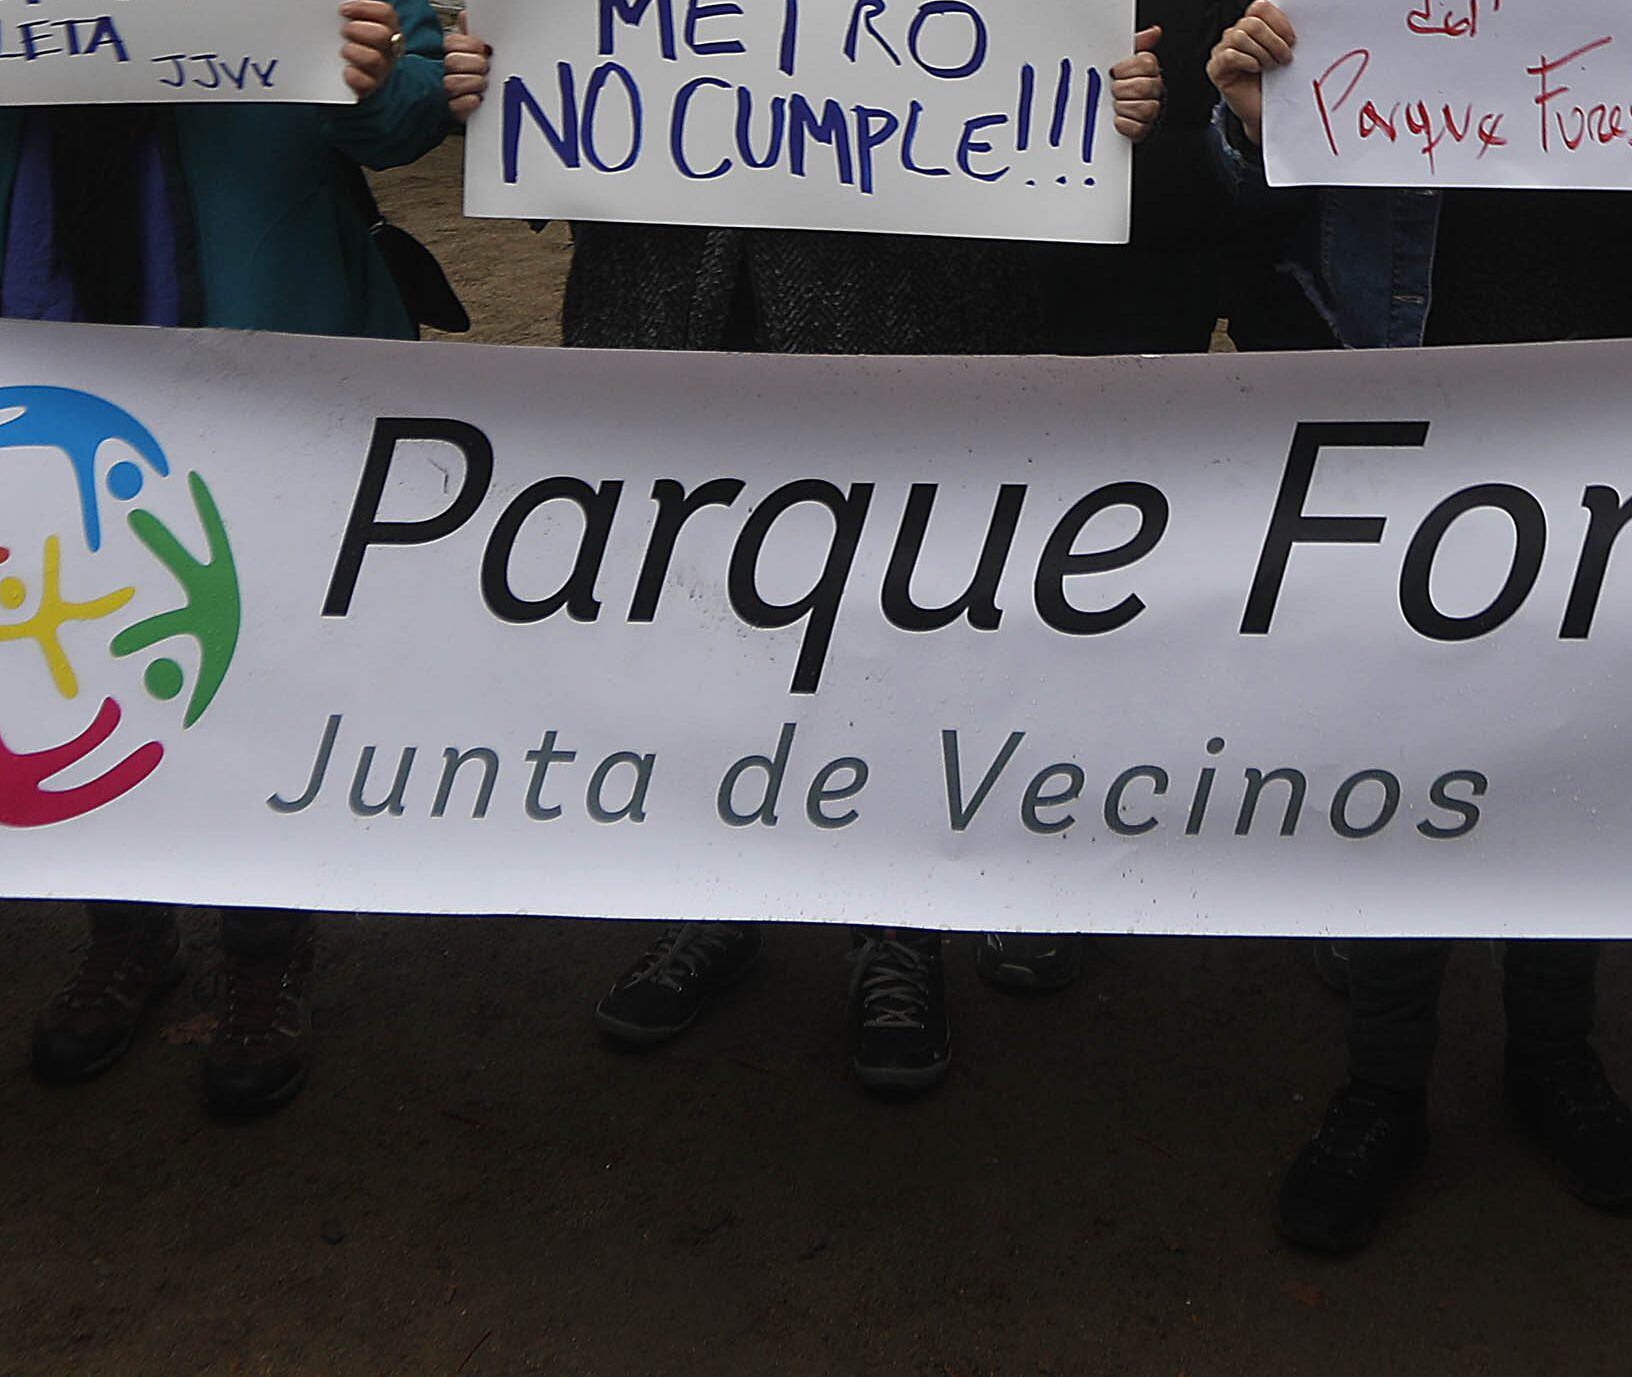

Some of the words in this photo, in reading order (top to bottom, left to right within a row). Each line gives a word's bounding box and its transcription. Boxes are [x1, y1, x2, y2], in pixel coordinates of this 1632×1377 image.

[501, 59, 644, 186] NO
[671, 56, 1102, 196] CUMPLE!!!
[1312, 48, 1508, 175] Parque
[321, 415, 1172, 696] Parque
[265, 711, 654, 825] Junta
[715, 721, 872, 829] de
[939, 727, 1491, 840] Vecinos
